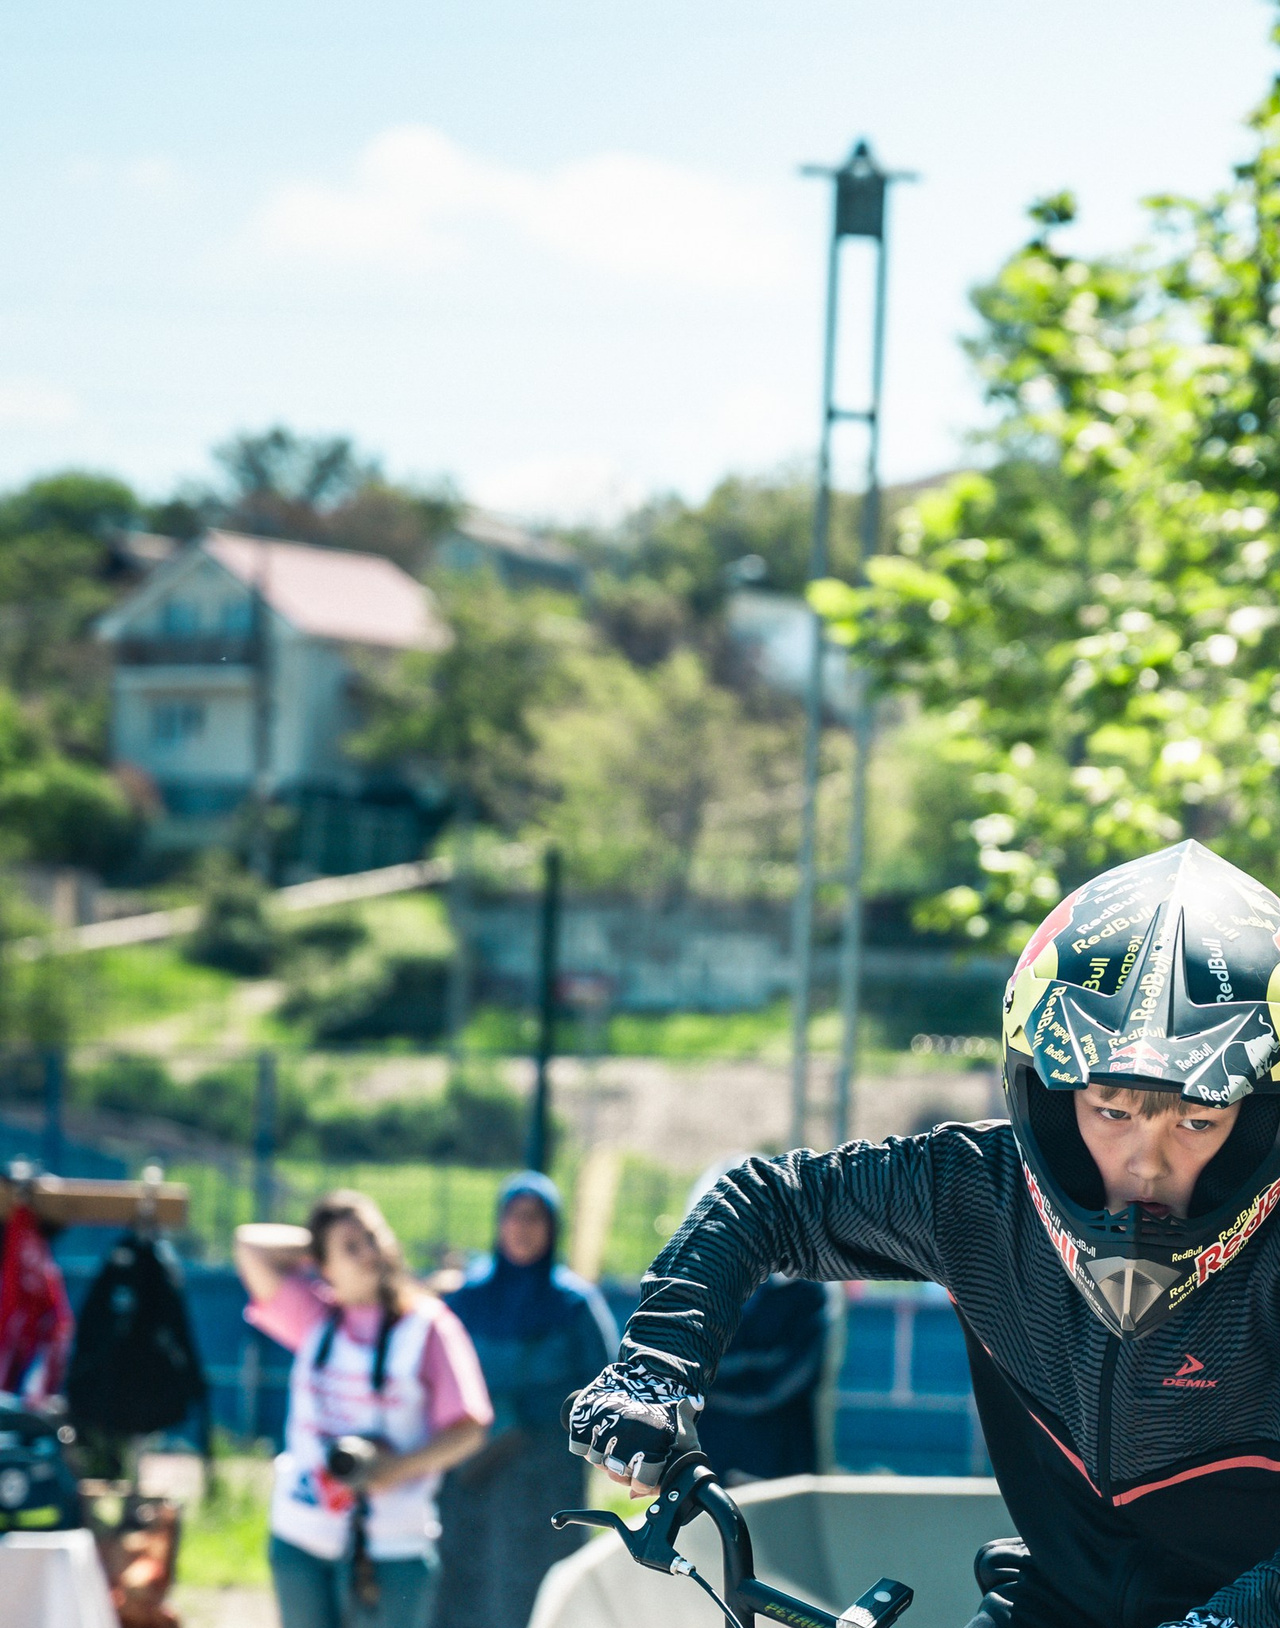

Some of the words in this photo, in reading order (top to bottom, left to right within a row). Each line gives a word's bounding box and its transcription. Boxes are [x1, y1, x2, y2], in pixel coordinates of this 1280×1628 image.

[1071, 905, 1155, 954] RedBull
[1075, 891, 1147, 935] RedBull
[1129, 953, 1173, 1021] RedBull
[1201, 937, 1235, 1003] RedBull
[1032, 985, 1068, 1051] RedBull
[1107, 1027, 1166, 1048] RedBull
[1109, 1060, 1163, 1078] RedBull
[1175, 1042, 1215, 1072] RedBull
[1171, 1245, 1203, 1263] RedBull
[1162, 1378, 1218, 1388] DEMIX
